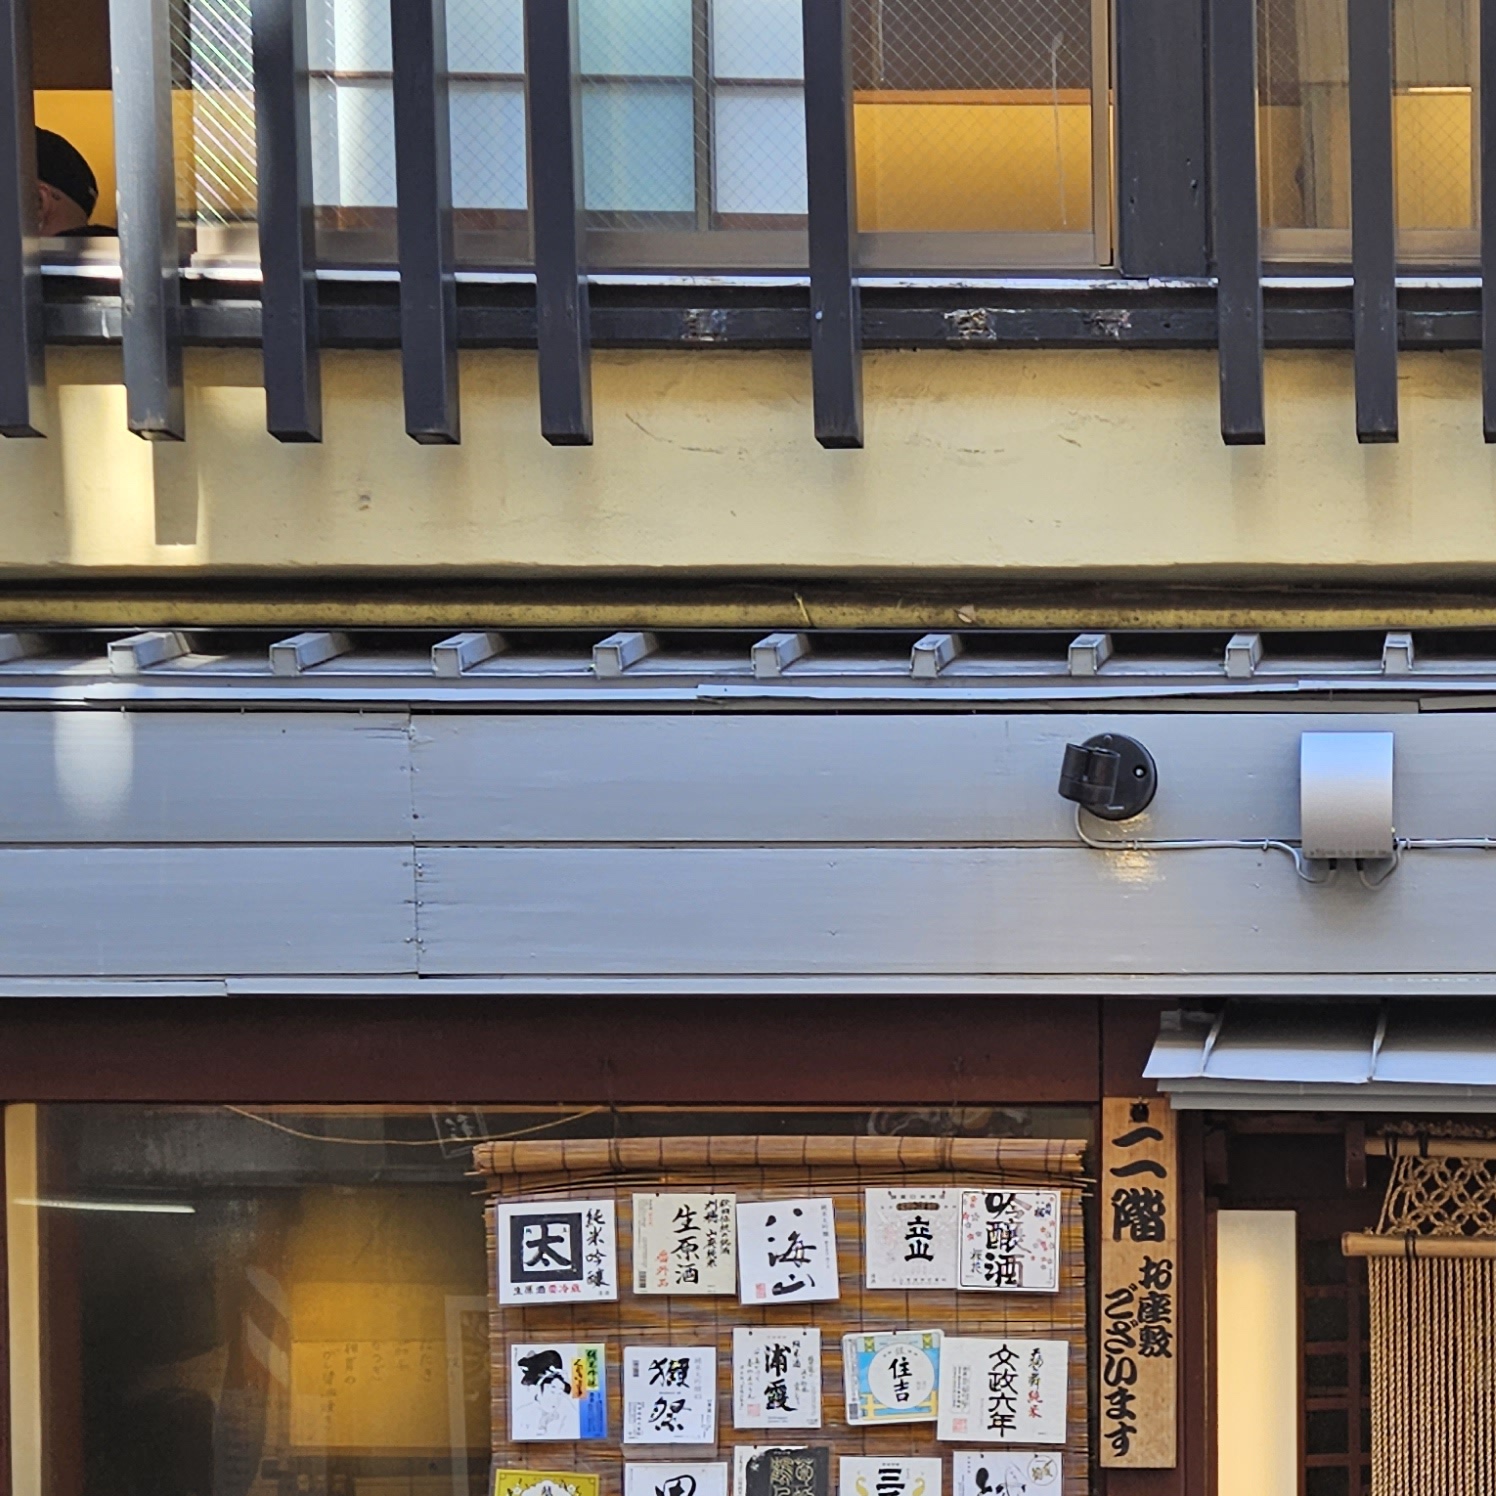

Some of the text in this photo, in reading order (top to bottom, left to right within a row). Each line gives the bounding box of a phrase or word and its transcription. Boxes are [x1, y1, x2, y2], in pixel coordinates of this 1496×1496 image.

[671, 1203, 702, 1285] 生原酒
[764, 1207, 818, 1296] 八海山
[904, 1215, 934, 1262] 立山
[1137, 1255, 1173, 1358] お座敷
[648, 1357, 692, 1432] 獺祭
[763, 1343, 798, 1412] 浦霞
[888, 1356, 913, 1402] 住吉
[987, 1343, 1020, 1438] 文政六年
[1103, 1283, 1139, 1459] ございます
